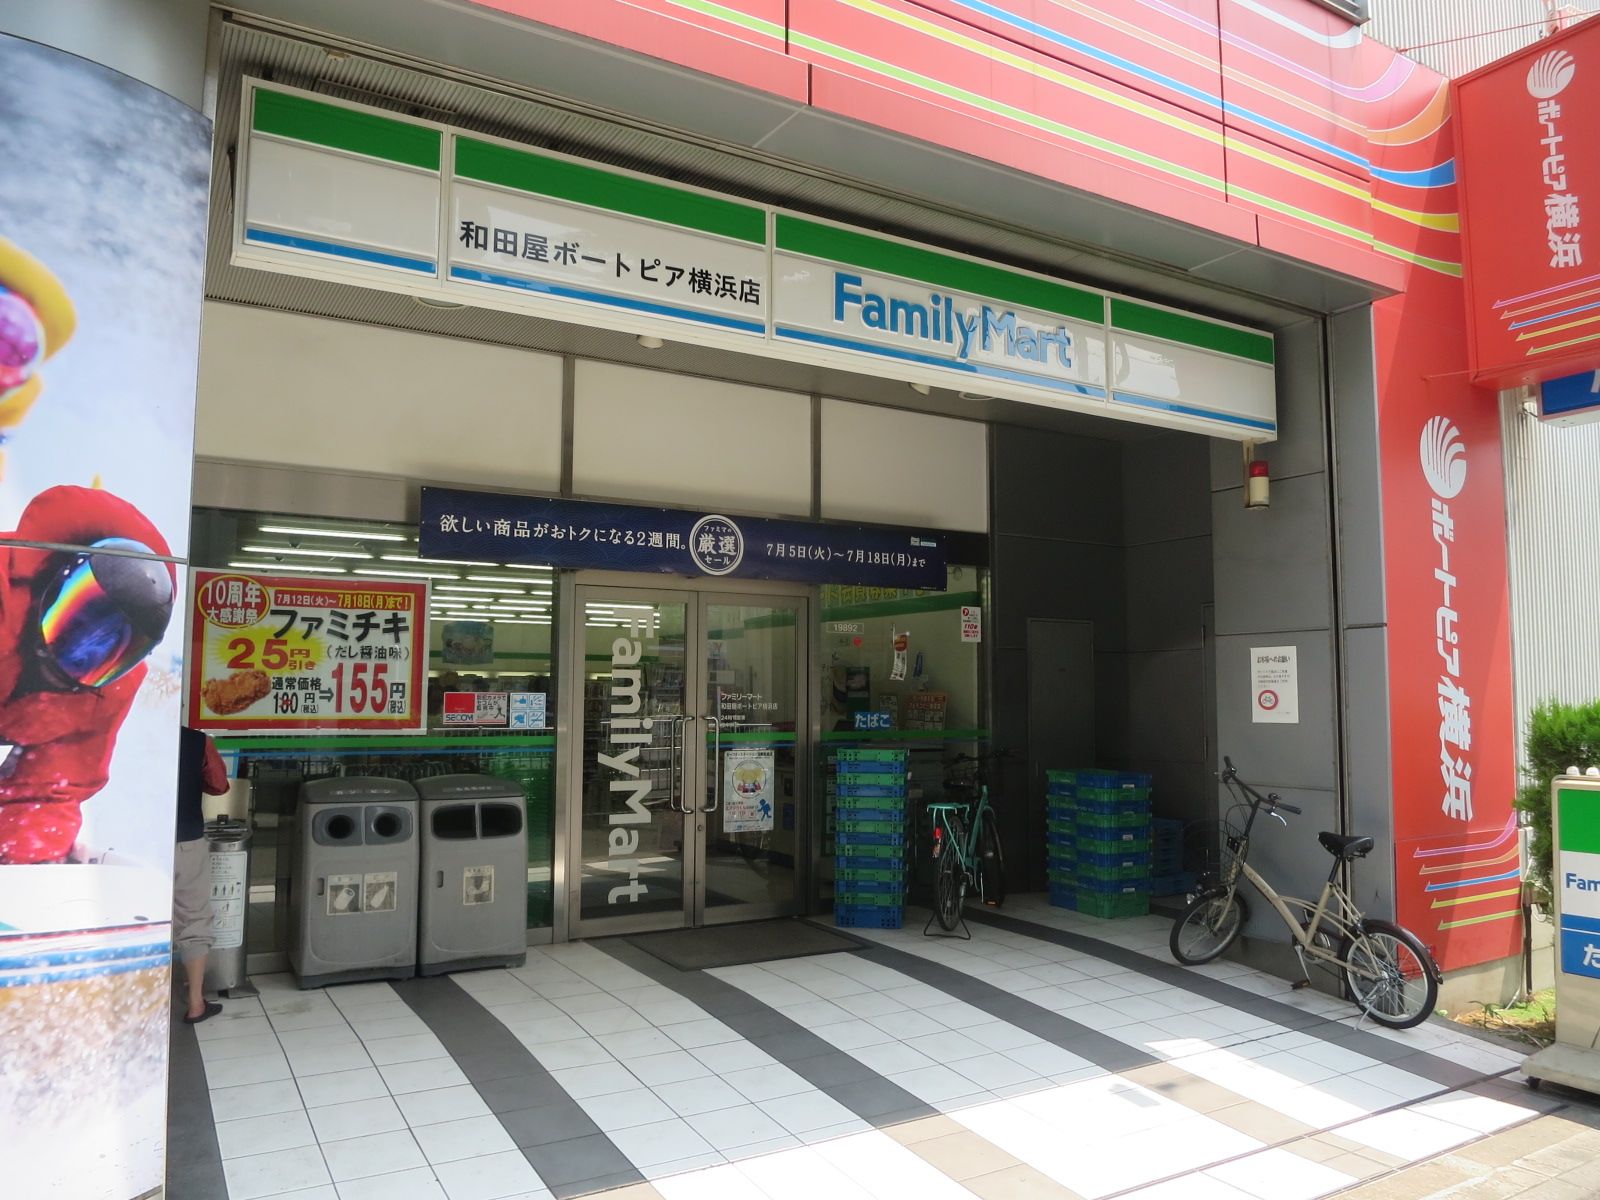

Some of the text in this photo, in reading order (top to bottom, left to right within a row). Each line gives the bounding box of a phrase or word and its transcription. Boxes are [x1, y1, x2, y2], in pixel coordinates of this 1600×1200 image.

[1536, 99, 1582, 269] ボートピア横浜
[459, 220, 761, 305] 和田屋ボートピア横浜店
[833, 271, 1072, 368] FamilyMart
[439, 514, 687, 550] 欲しい商品がおトクになる2週間。
[697, 533, 737, 556] 厳選
[704, 555, 731, 566] セール
[206, 580, 261, 608] 10周年
[207, 607, 259, 624] 大感謝祭
[269, 608, 410, 643] ファミチキ
[1431, 498, 1473, 823] ボートピア横浜
[271, 676, 322, 691] 通常価格
[720, 693, 762, 701] ファミリーマート
[445, 713, 474, 722] SECOM
[854, 713, 890, 728] たばこ
[597, 608, 655, 905] FamilyMart
